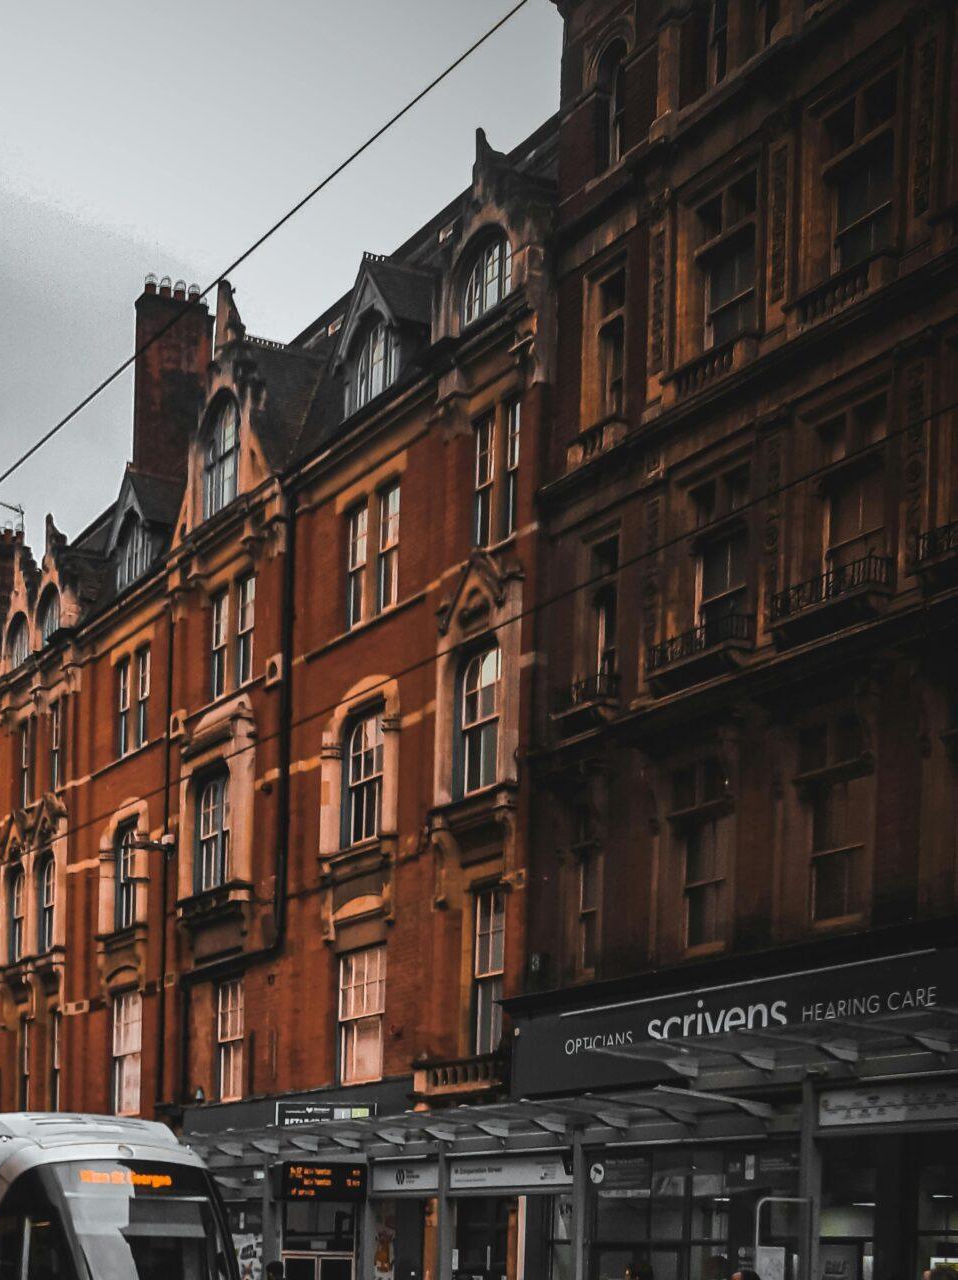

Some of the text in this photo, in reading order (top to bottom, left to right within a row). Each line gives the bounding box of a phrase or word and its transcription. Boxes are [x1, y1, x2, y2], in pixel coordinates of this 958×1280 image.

[565, 986, 937, 1055] OPTICIANS scrivens HEARING CARE
